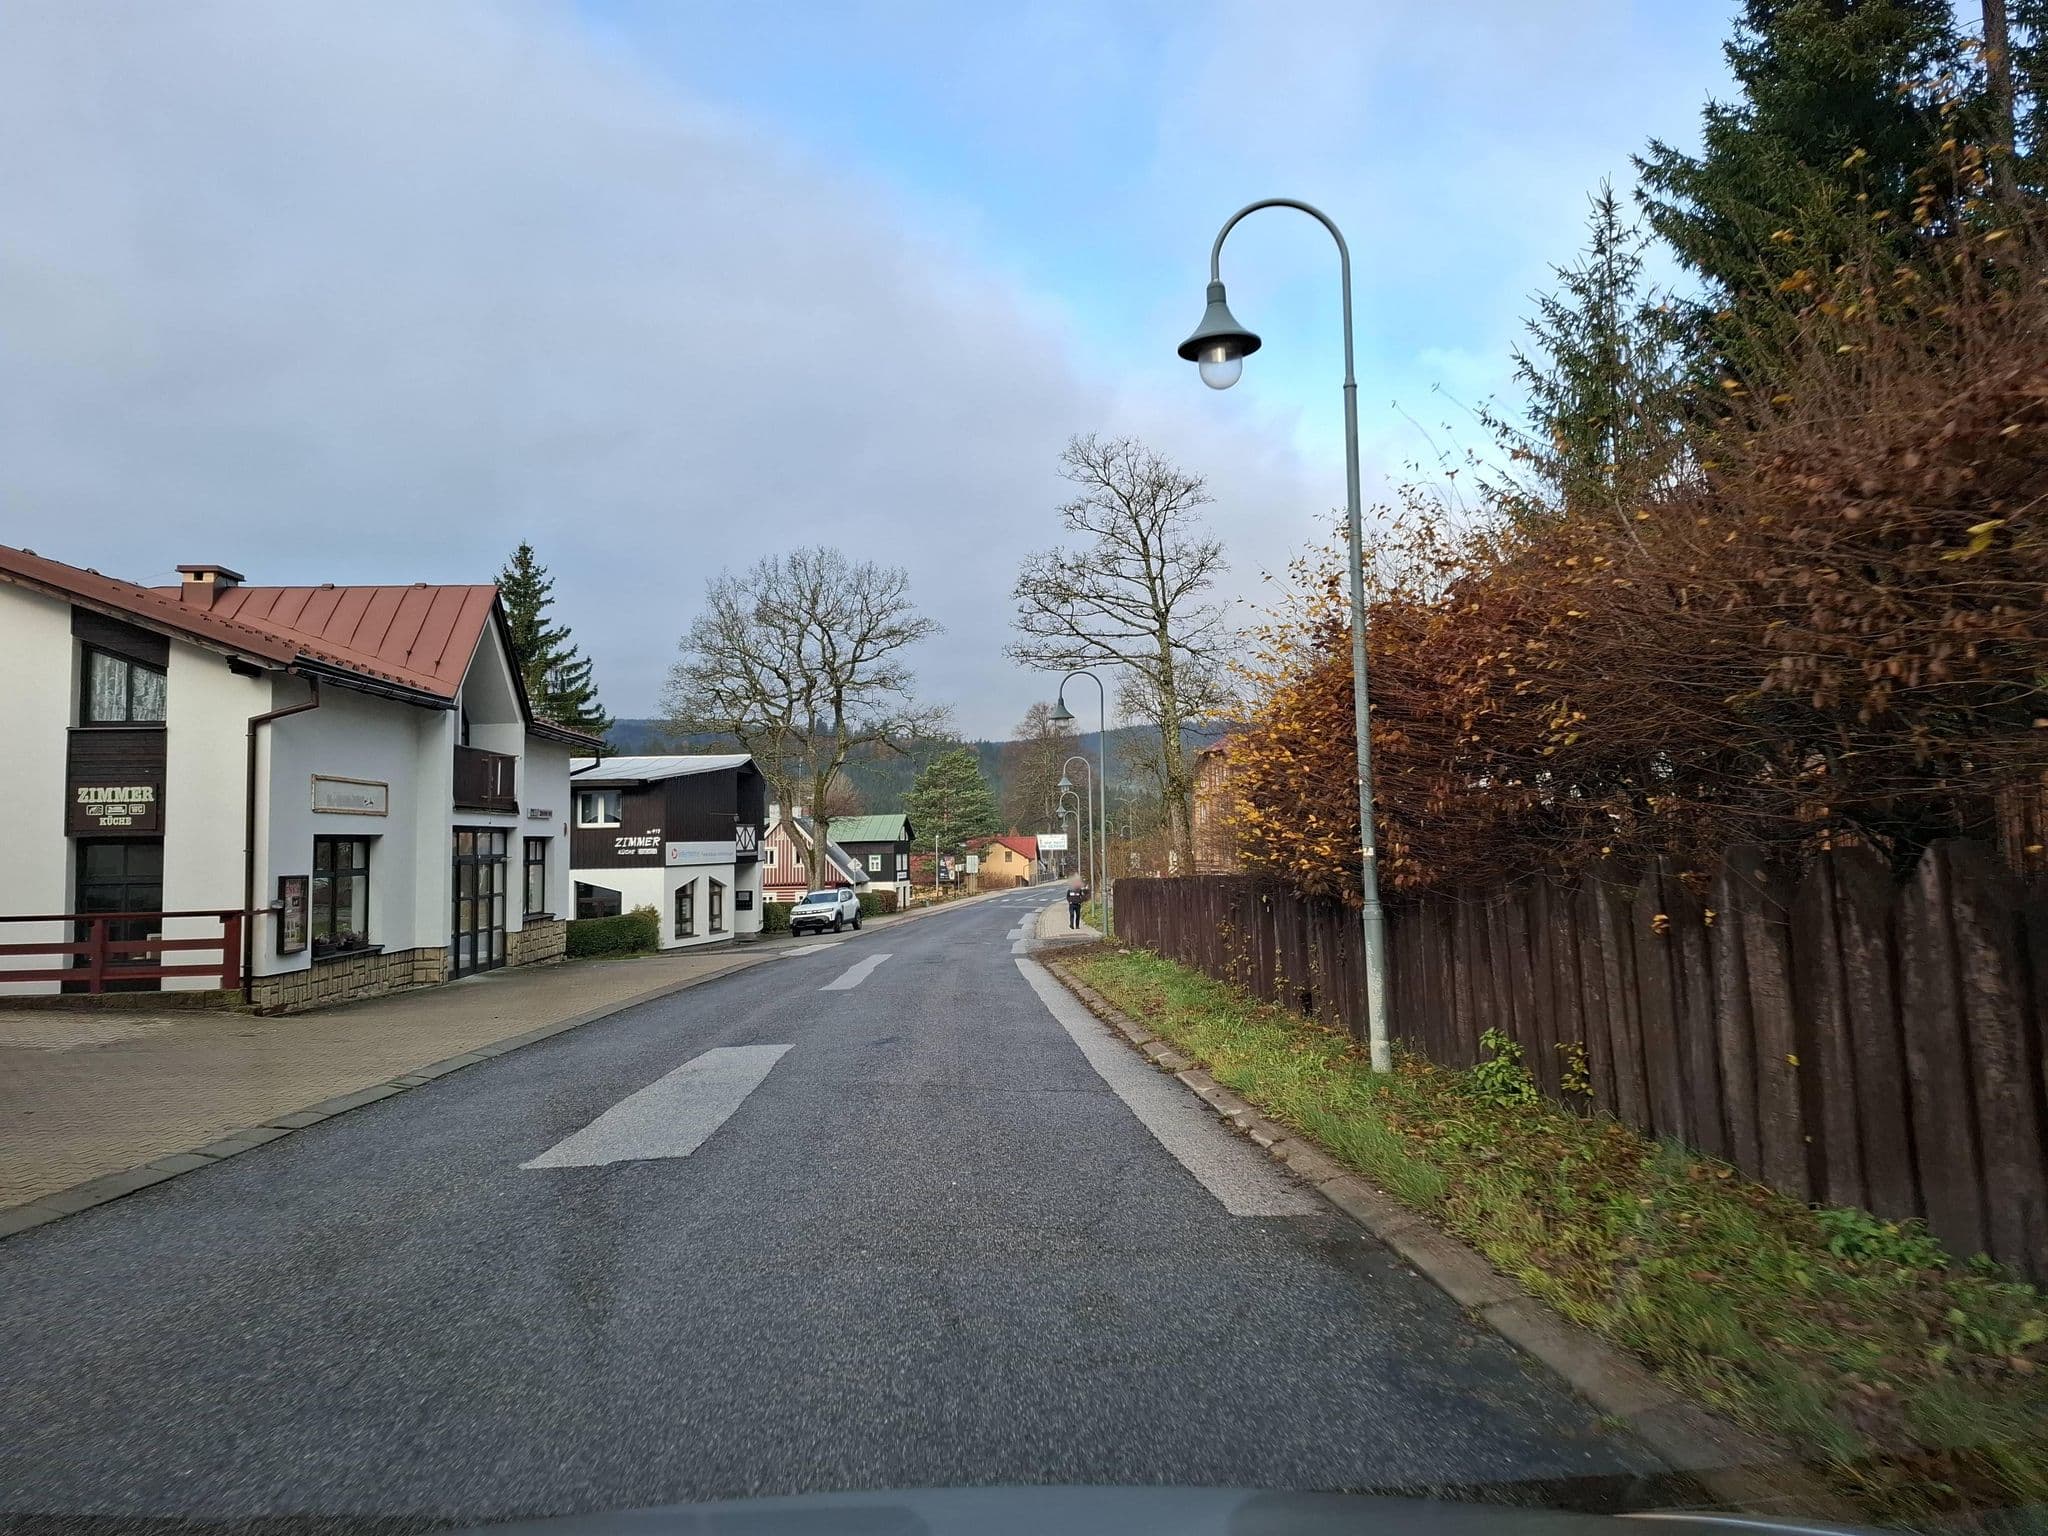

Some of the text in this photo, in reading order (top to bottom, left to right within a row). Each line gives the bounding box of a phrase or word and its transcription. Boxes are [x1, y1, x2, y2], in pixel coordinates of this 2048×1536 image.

[77, 786, 154, 803] ZIMMER
[131, 805, 143, 813] WC
[99, 815, 132, 826] KÜCHE
[614, 836, 661, 848] ZIMMER
